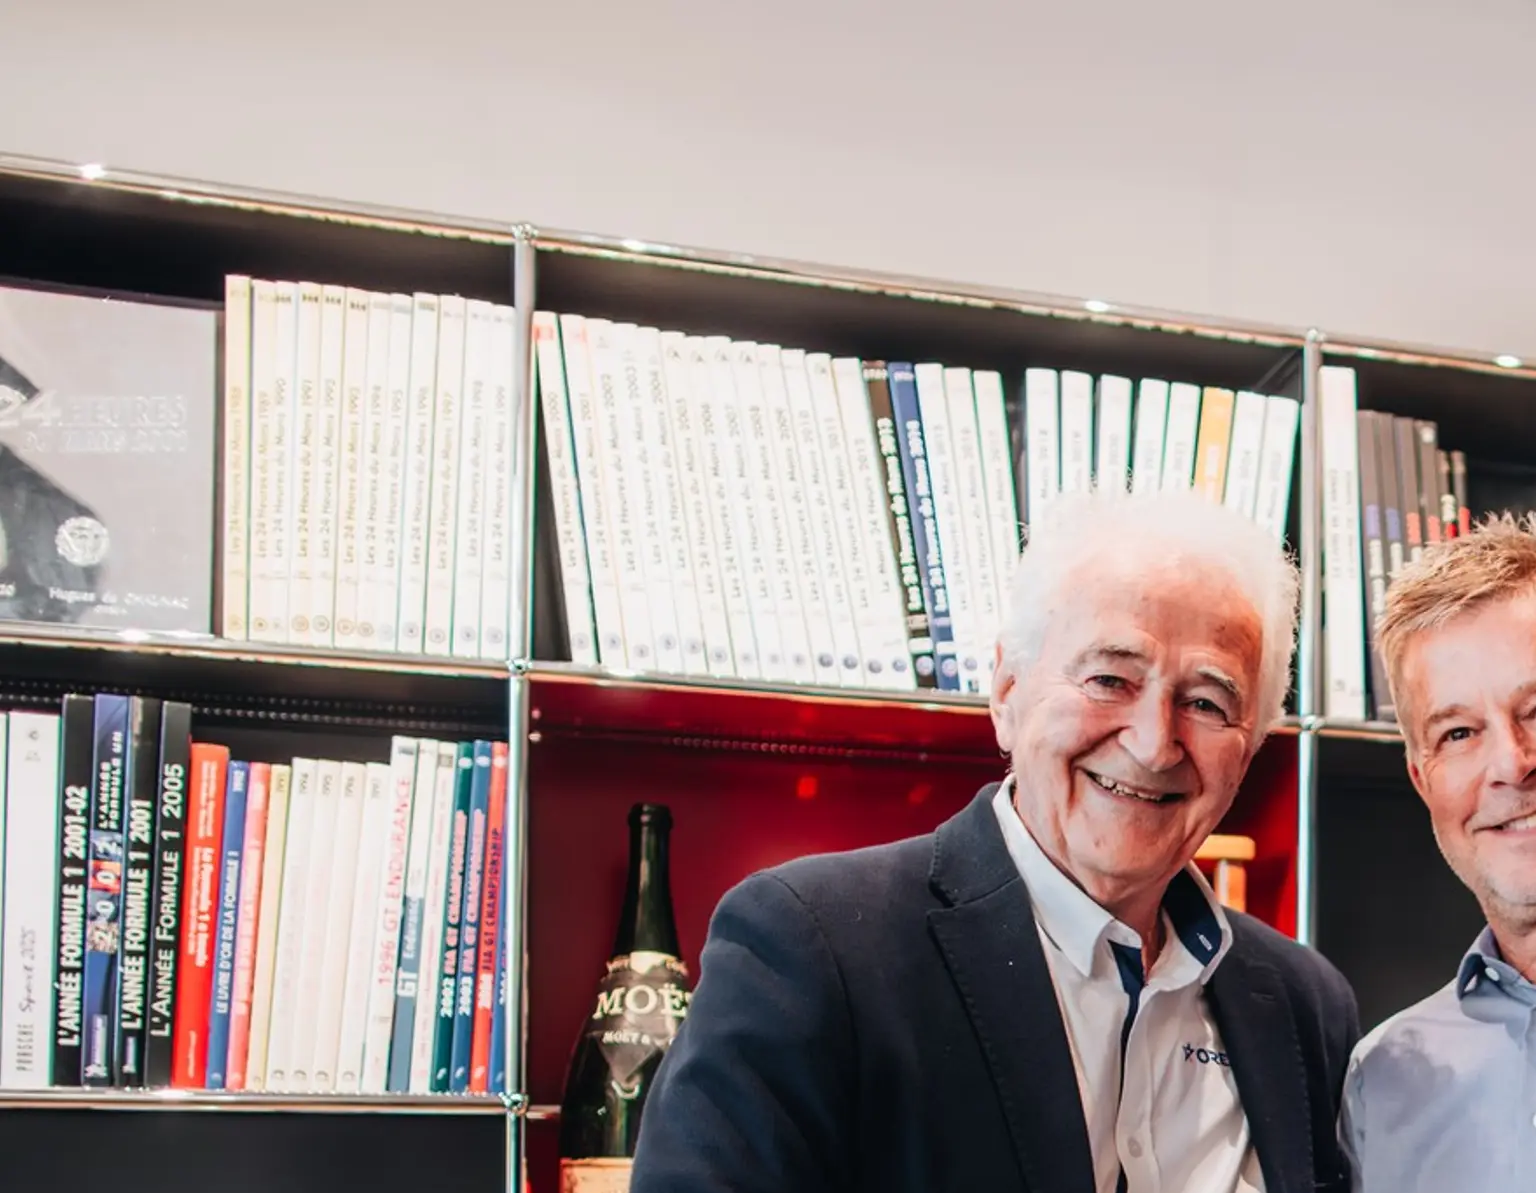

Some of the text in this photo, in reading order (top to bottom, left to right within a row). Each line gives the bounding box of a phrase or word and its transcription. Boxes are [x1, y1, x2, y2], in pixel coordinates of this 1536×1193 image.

[163, 762, 184, 819] 2005
[130, 798, 152, 843] 2001
[162, 829, 180, 841] 1
[129, 850, 149, 861] 1
[54, 785, 89, 1046] L'ANNÉE FORMULE 1 2001-02
[125, 867, 149, 951] FORMULE
[384, 907, 399, 932] GT
[118, 954, 147, 1029] L'ANNÉE
[397, 966, 417, 998] GT
[217, 1000, 229, 1014] LE
[17, 1022, 34, 1072] PORSCHE
